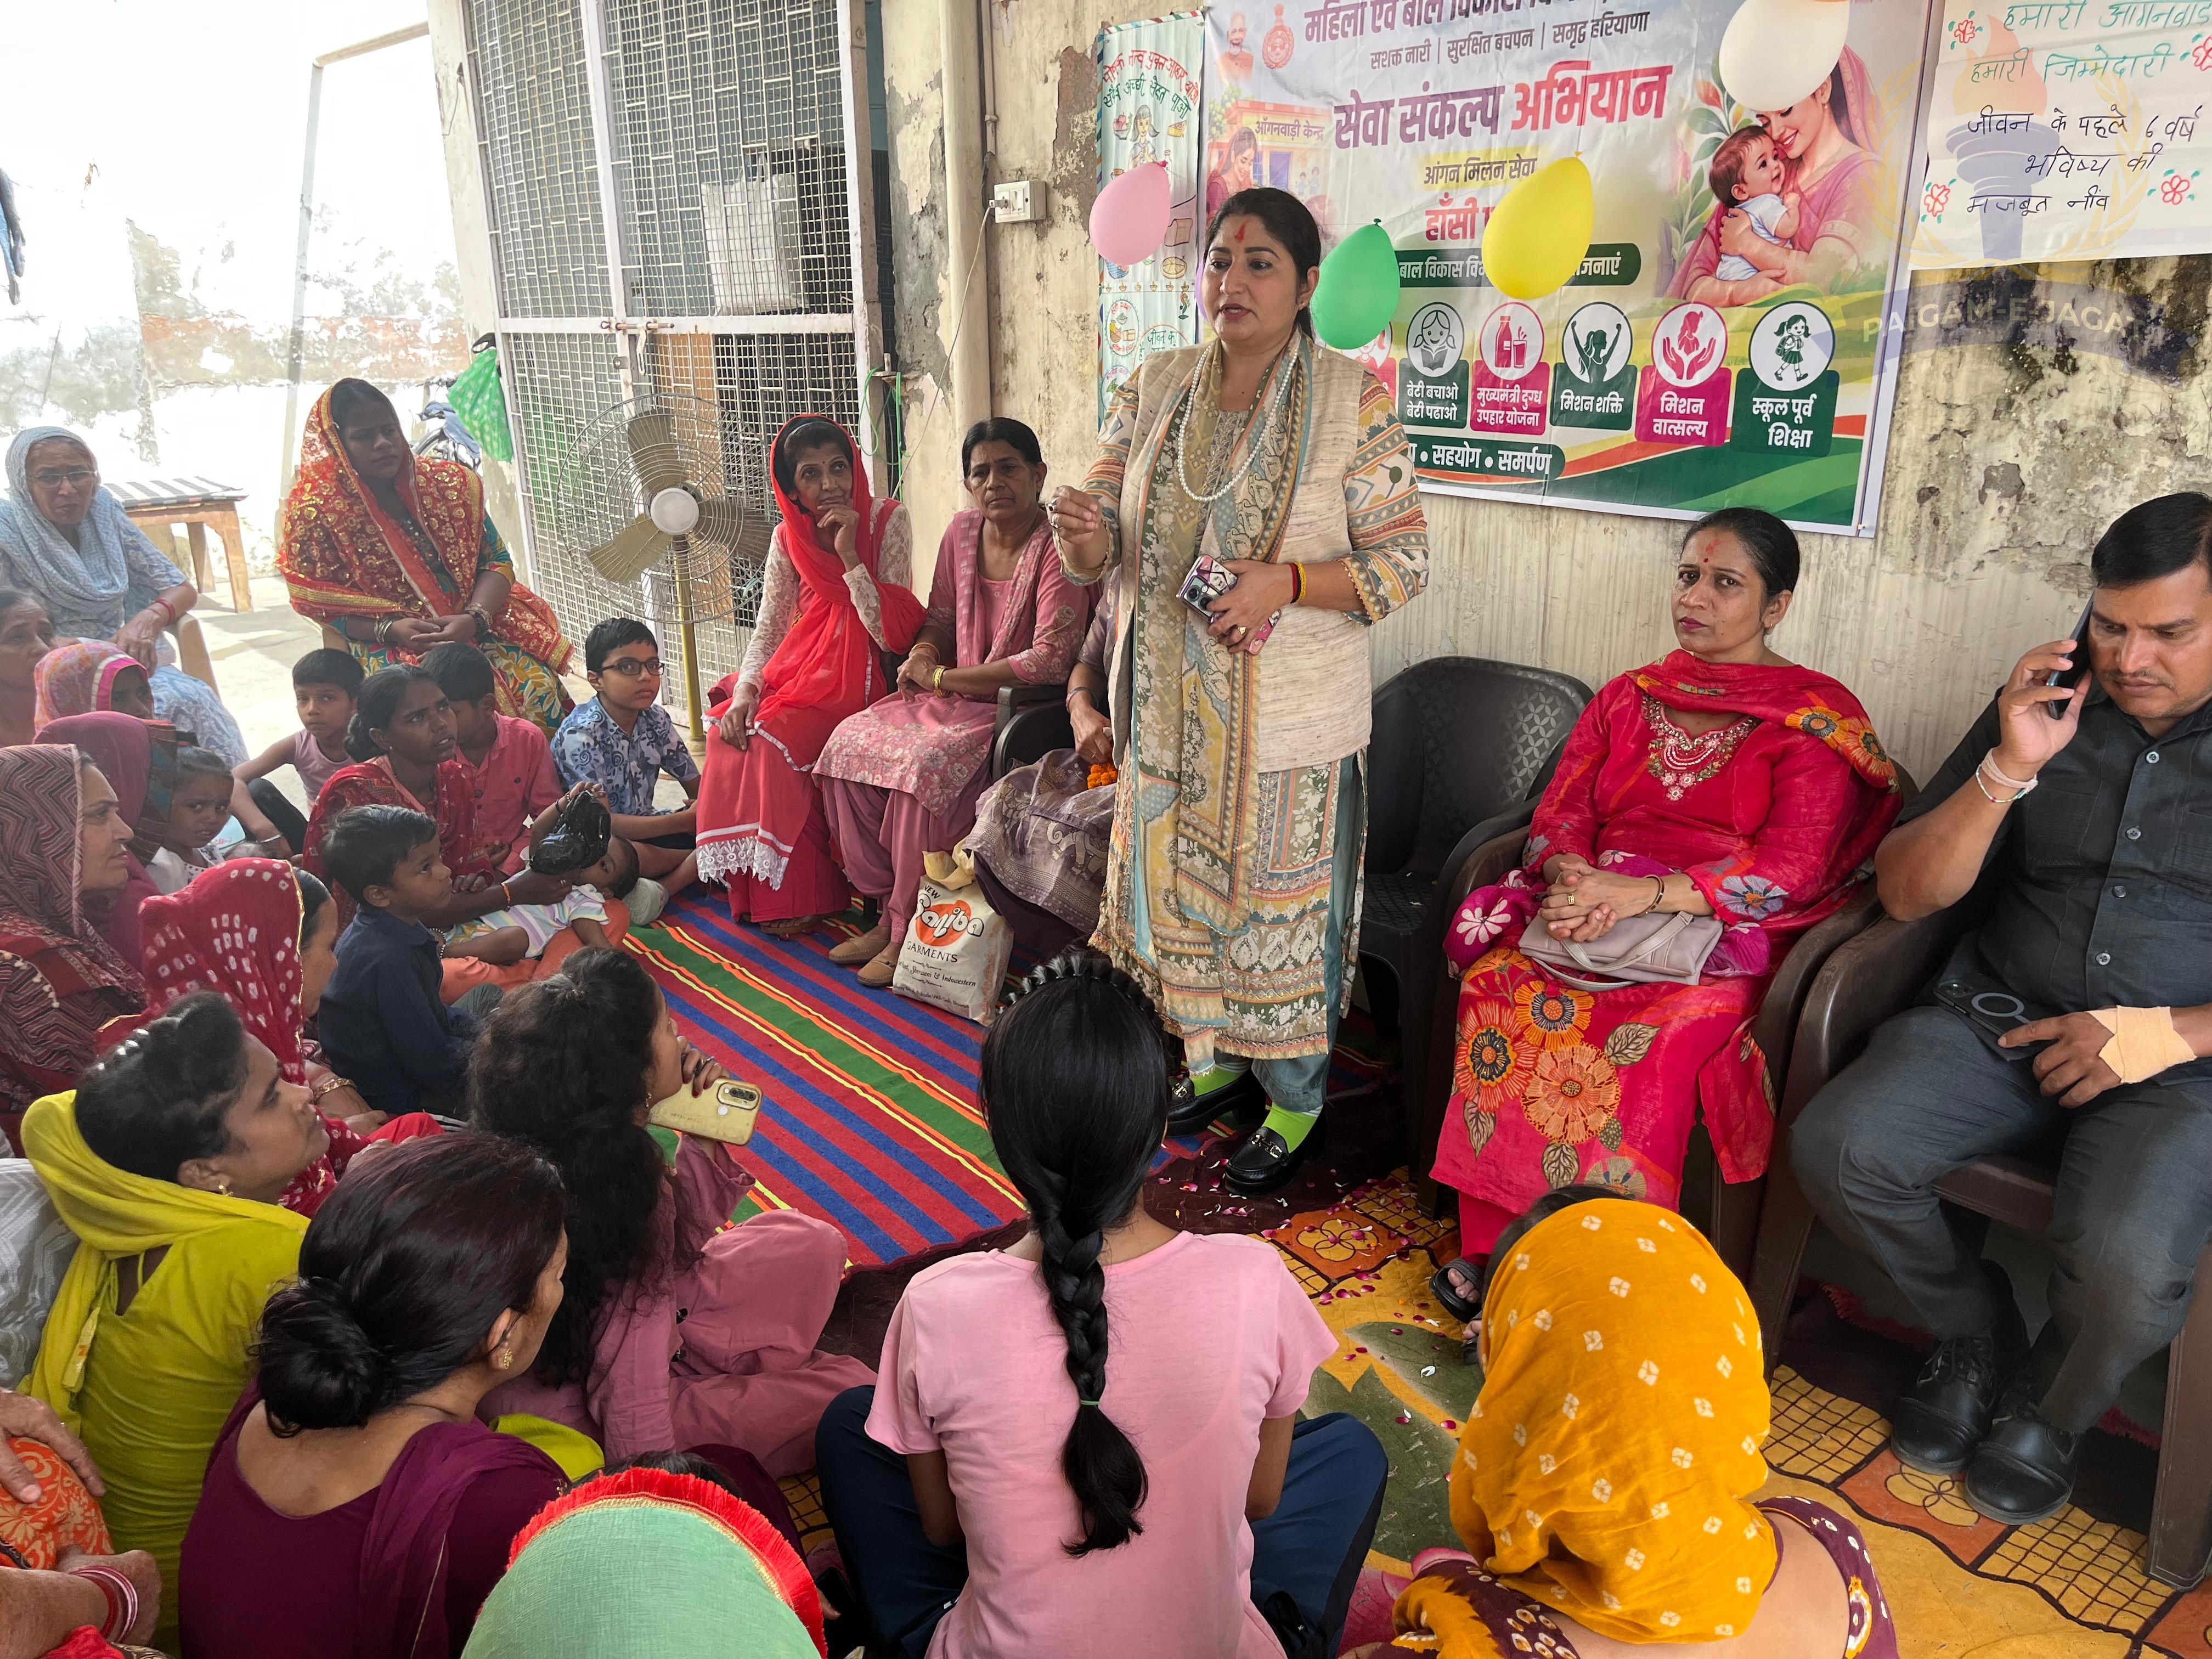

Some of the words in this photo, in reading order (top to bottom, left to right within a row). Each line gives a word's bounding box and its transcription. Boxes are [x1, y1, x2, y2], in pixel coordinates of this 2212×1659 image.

[1304, 1, 1365, 43] महिला
[1371, 0, 1396, 34] एव
[1371, 50, 1401, 70] सशक्त
[1406, 38, 1431, 65] नारी
[1447, 31, 1493, 64] सुरक्षित
[1494, 28, 1535, 52] बचपन
[1591, 11, 1650, 38] हरियाणा
[1971, 47, 2031, 83] हमारी
[2044, 43, 2175, 84] जिम्मेदारी
[1334, 89, 1395, 150] सेवा
[1398, 81, 1505, 143] संकल्प
[1511, 60, 1673, 131] अभियान
[1967, 105, 2034, 136] जीवन
[2051, 108, 2067, 133] के
[2079, 104, 2128, 138] पहले
[2146, 115, 2159, 138] 6
[2165, 105, 2203, 142] वर्ष
[1424, 161, 1459, 185] आंगन
[1464, 157, 1507, 183] मिलन
[1509, 153, 1538, 179] सेवा
[2025, 145, 2126, 178] भविष्य
[2127, 142, 2165, 173] की
[1425, 192, 1479, 241] हाँसी
[1967, 194, 2053, 217] मजबूत
[1400, 261, 1423, 279] बाल
[1425, 256, 1465, 279] विकास
[1576, 251, 1622, 276] जनाएं
[1407, 380, 1425, 398] बेटी
[1426, 382, 1459, 400] बचाओ
[1476, 384, 1520, 407] मुख्यमंत्री
[1522, 389, 1543, 410] दुग्ध
[1560, 389, 1594, 413] मिशन
[1595, 391, 1624, 414] शक्ति
[1660, 391, 1705, 415] मिशन
[1407, 400, 1424, 419] बेटी
[1476, 409, 1505, 426] उपहार
[1506, 407, 1540, 427] योजना
[1752, 397, 1790, 422] स्कूल
[1791, 393, 1818, 424] पूर्व
[1653, 418, 1708, 437] वात्सल्य
[1768, 422, 1814, 448] शिक्षा
[1432, 441, 1482, 469] सहयोग
[1498, 446, 1553, 475] समर्पण
[907, 941, 958, 963] GARMENTS
[942, 974, 977, 986] Indowestern
